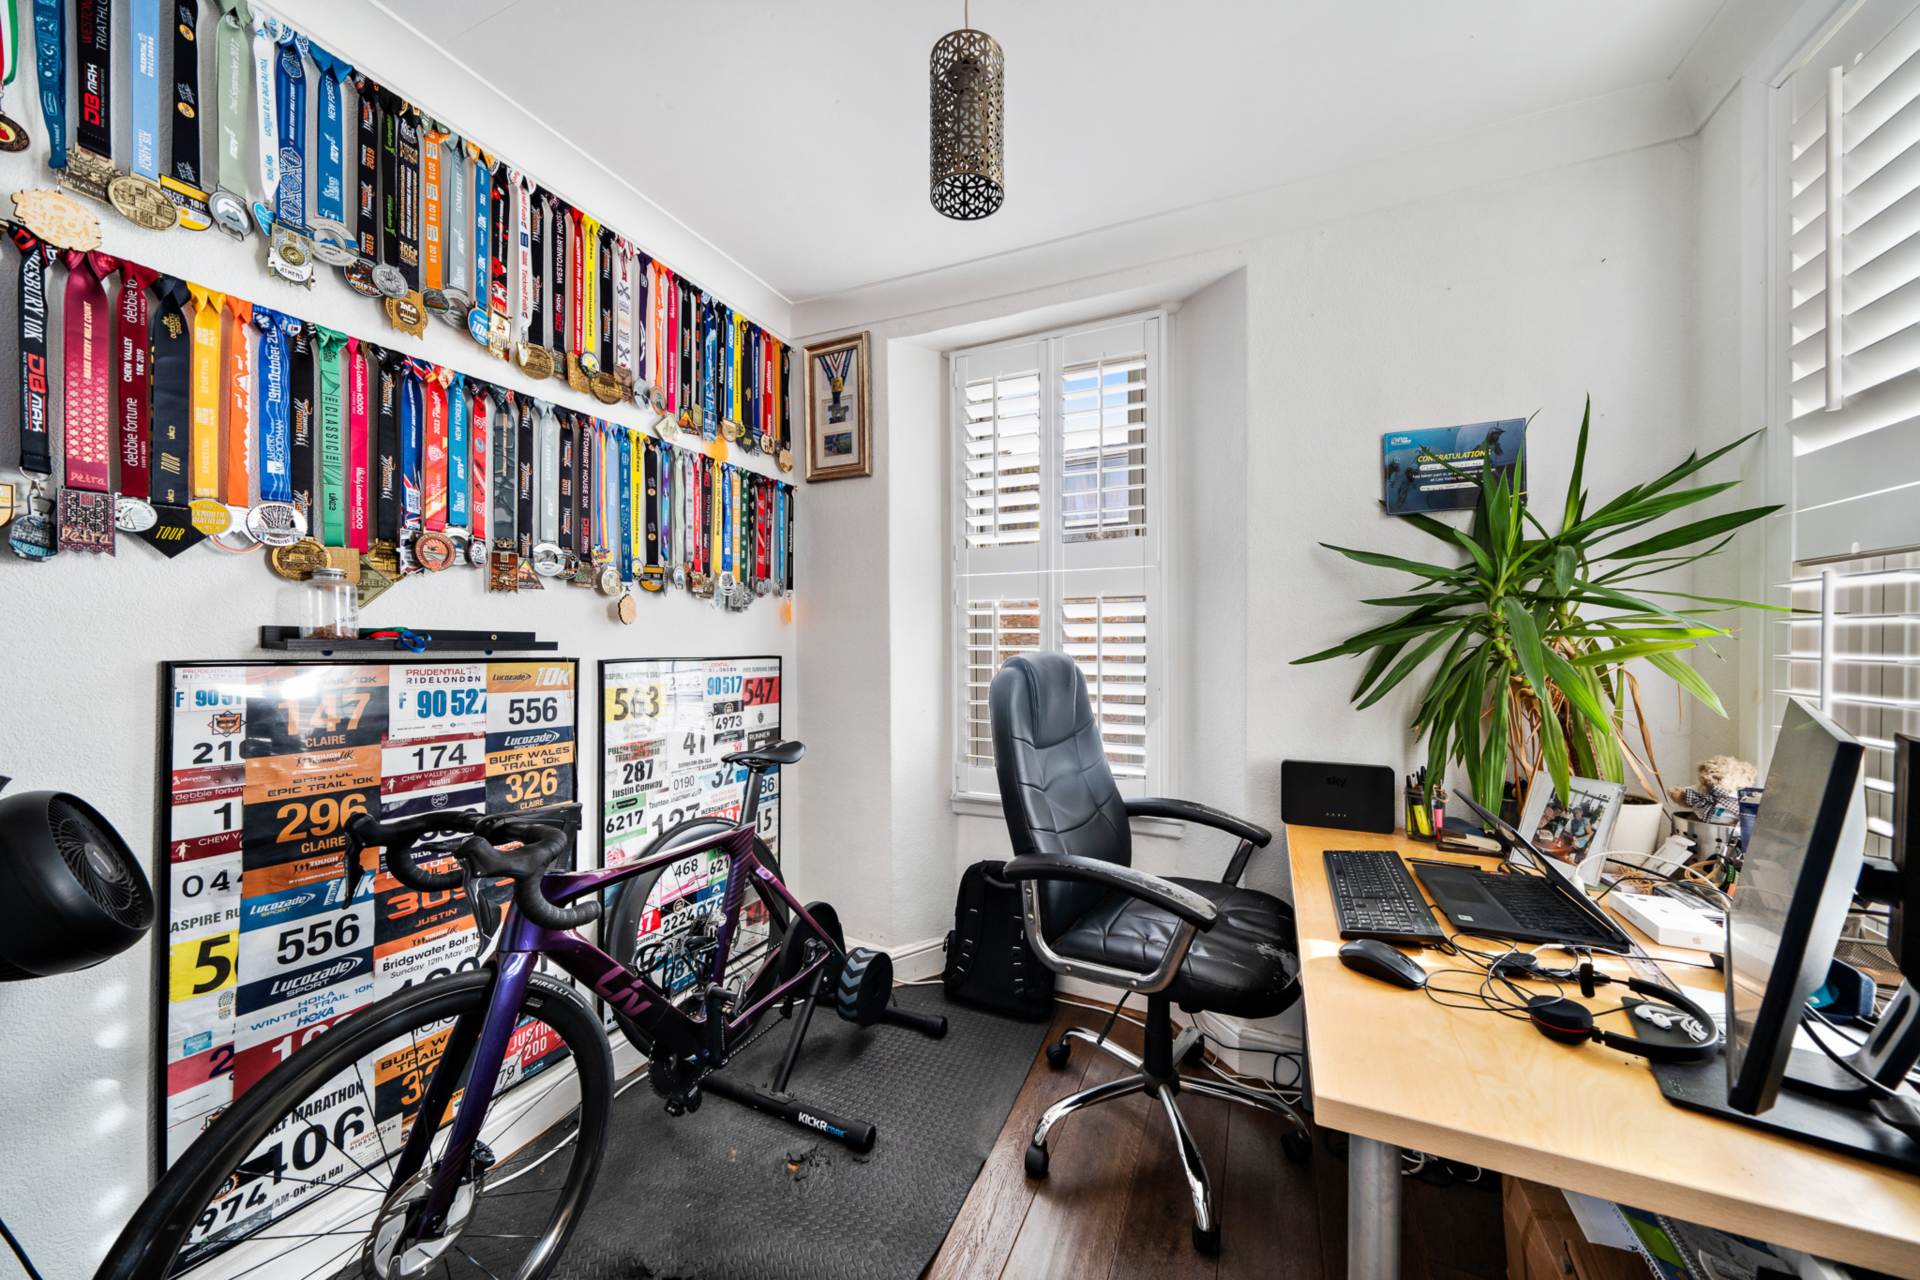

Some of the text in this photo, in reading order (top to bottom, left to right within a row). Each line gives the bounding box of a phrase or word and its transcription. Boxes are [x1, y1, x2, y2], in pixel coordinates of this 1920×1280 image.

[124, 291, 137, 323] debbie
[123, 337, 133, 382] CHEW VALLEY
[267, 345, 281, 380] October
[123, 397, 138, 467] debbie fortune
[325, 405, 339, 451] CLASSIC
[156, 525, 185, 541] TOUR
[406, 668, 466, 676] PRUDENTIAL
[406, 676, 481, 685] RIDELONDON
[492, 666, 571, 687] Lucozade 10K
[743, 677, 776, 705] 547
[278, 692, 371, 736] 147
[508, 696, 558, 725] 556
[715, 715, 743, 730] 4973
[305, 735, 346, 748] CLAIRE
[504, 733, 555, 748] Lucozade
[412, 743, 467, 771] 174
[489, 746, 570, 765] BUFF WALES
[501, 759, 537, 772] TRAIL
[401, 774, 423, 783] CHEW
[427, 777, 451, 787] Justin
[622, 758, 654, 785] 287
[267, 776, 374, 797] EPIC TRAIL 10K
[505, 768, 559, 805] 326
[612, 779, 663, 799] Justin Conway
[673, 775, 695, 791] 0190
[174, 791, 213, 801] debbie
[519, 799, 544, 810] CLAIRE
[276, 793, 368, 844] 296
[606, 809, 644, 833] 6217
[198, 834, 229, 846] CHEW
[301, 835, 346, 854] CLAIRE
[674, 858, 698, 878] 468
[250, 895, 315, 916] Lucozade
[170, 911, 221, 933] ASPIRE
[415, 908, 458, 927] JUSTIN
[276, 913, 360, 966] 556
[382, 935, 469, 972] Bridgwater Bolt
[390, 963, 424, 980] Sunday
[427, 956, 443, 968] 12th
[444, 950, 462, 963] May
[270, 961, 357, 997] Lucozade
[286, 979, 330, 998] SPORT
[529, 978, 569, 996] PIRELLI
[250, 983, 375, 1032] WINTER TRAIL 10K
[297, 991, 336, 1008] HOKA
[296, 1008, 335, 1028] HOKA
[523, 1036, 548, 1061] 200
[396, 1047, 445, 1072] TRAIL
[291, 1079, 365, 1125] MARATHON
[798, 1111, 829, 1132] KICKR
[196, 1182, 267, 1235] 974
